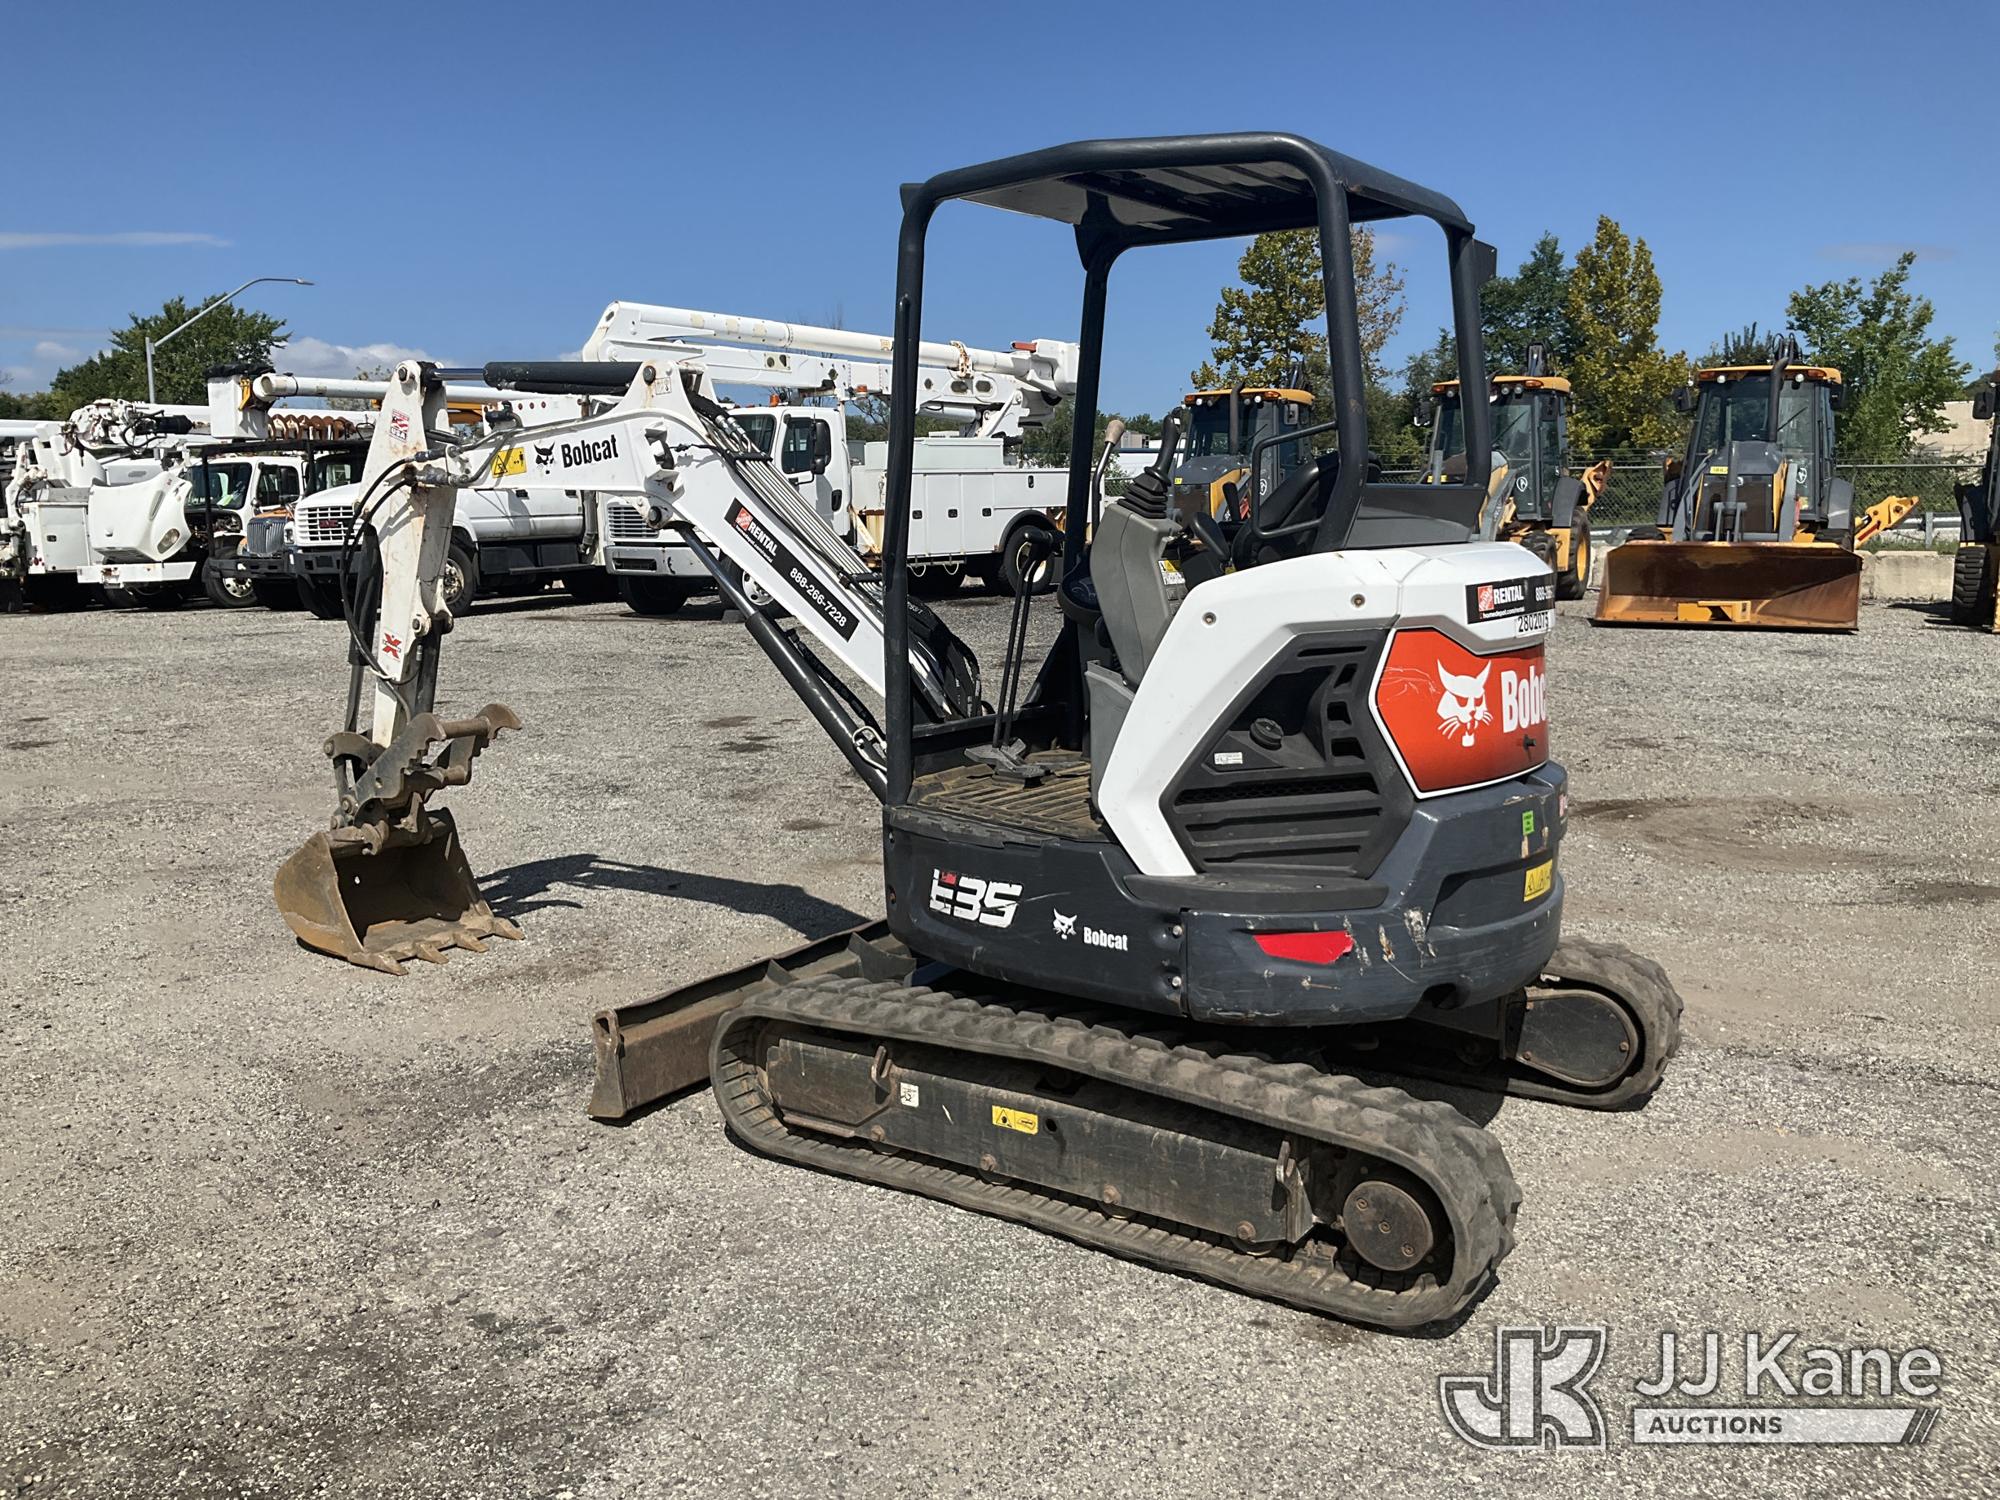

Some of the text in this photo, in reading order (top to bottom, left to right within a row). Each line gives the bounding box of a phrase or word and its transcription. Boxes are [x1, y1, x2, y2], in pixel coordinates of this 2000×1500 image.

[561, 434, 619, 468] Bobcat
[747, 520, 778, 557] RENTAL
[789, 567, 847, 627] 888-266-7228
[1493, 585, 1525, 605] RENTAL
[929, 868, 1023, 928] E35
[1083, 926, 1128, 951] Bobcat
